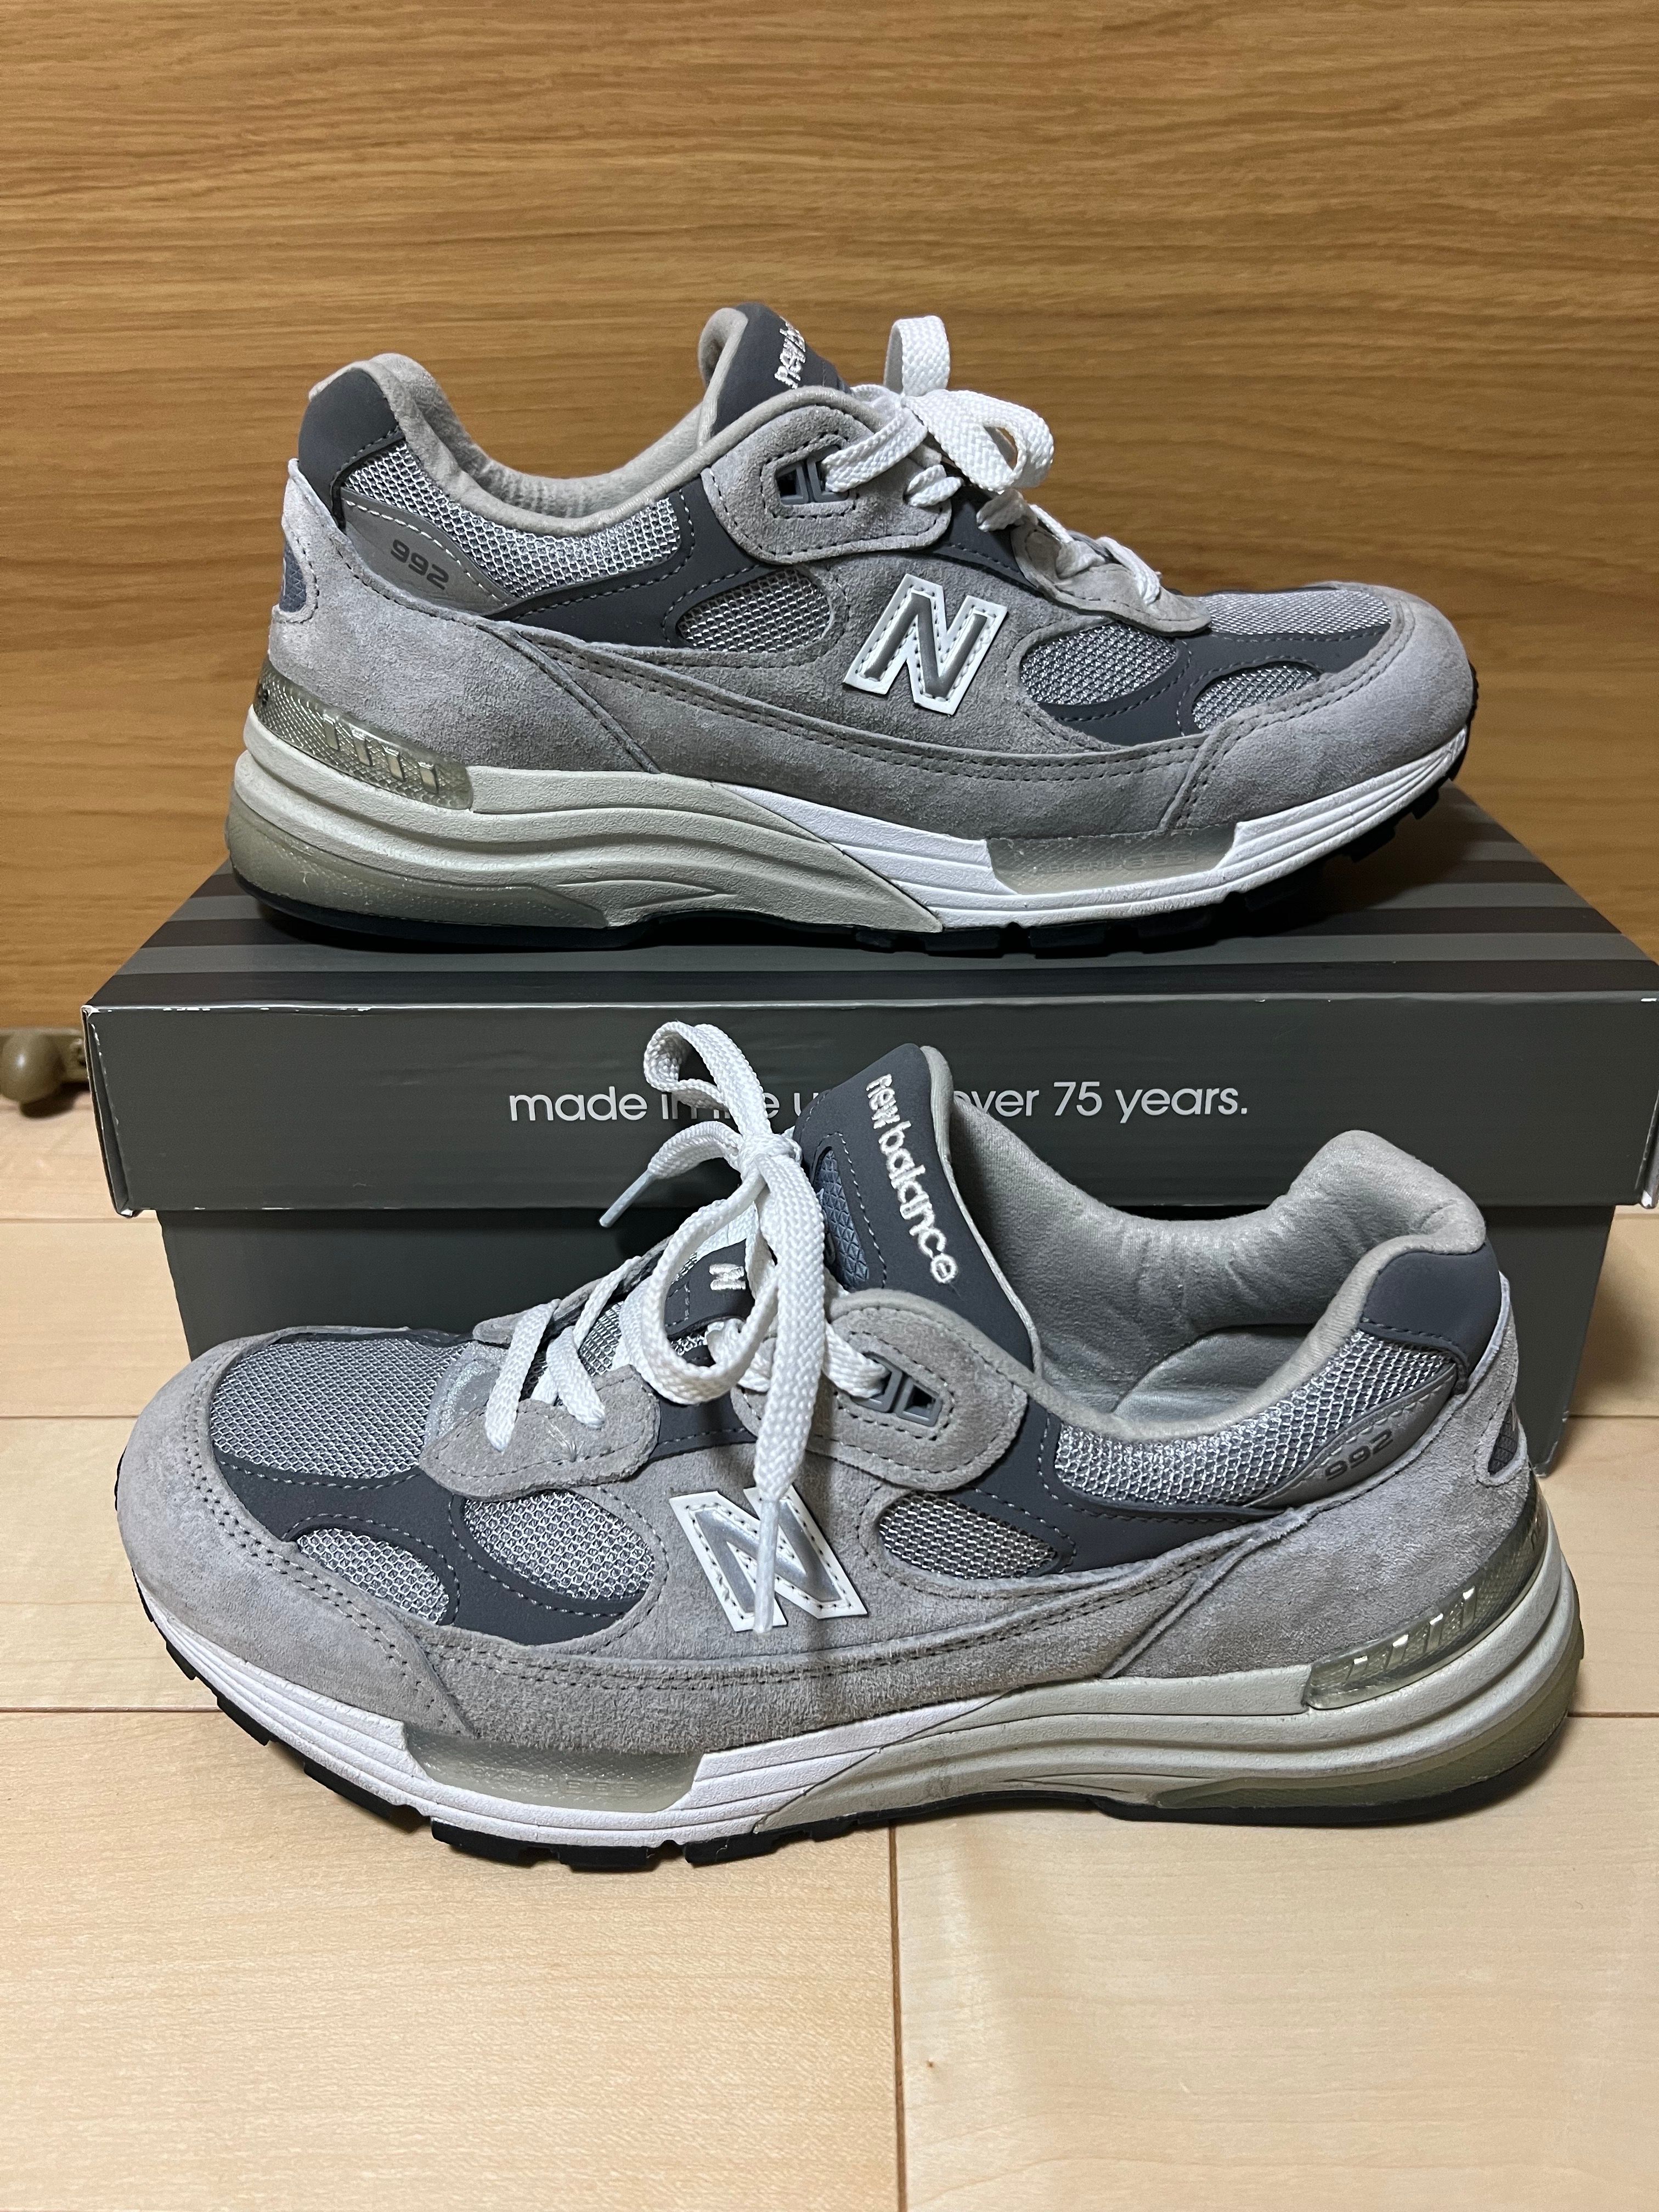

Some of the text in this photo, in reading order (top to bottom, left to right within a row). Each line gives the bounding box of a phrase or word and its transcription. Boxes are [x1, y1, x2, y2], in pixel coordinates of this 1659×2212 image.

[391, 539, 449, 590] 992
[843, 573, 1008, 715] N
[509, 1086, 648, 1121] made
[1053, 1081, 1102, 1116] 75
[1115, 1087, 1248, 1124] years.
[866, 1073, 959, 1284] new balance
[1325, 1429, 1393, 1481] 992
[669, 1483, 868, 1633] N
